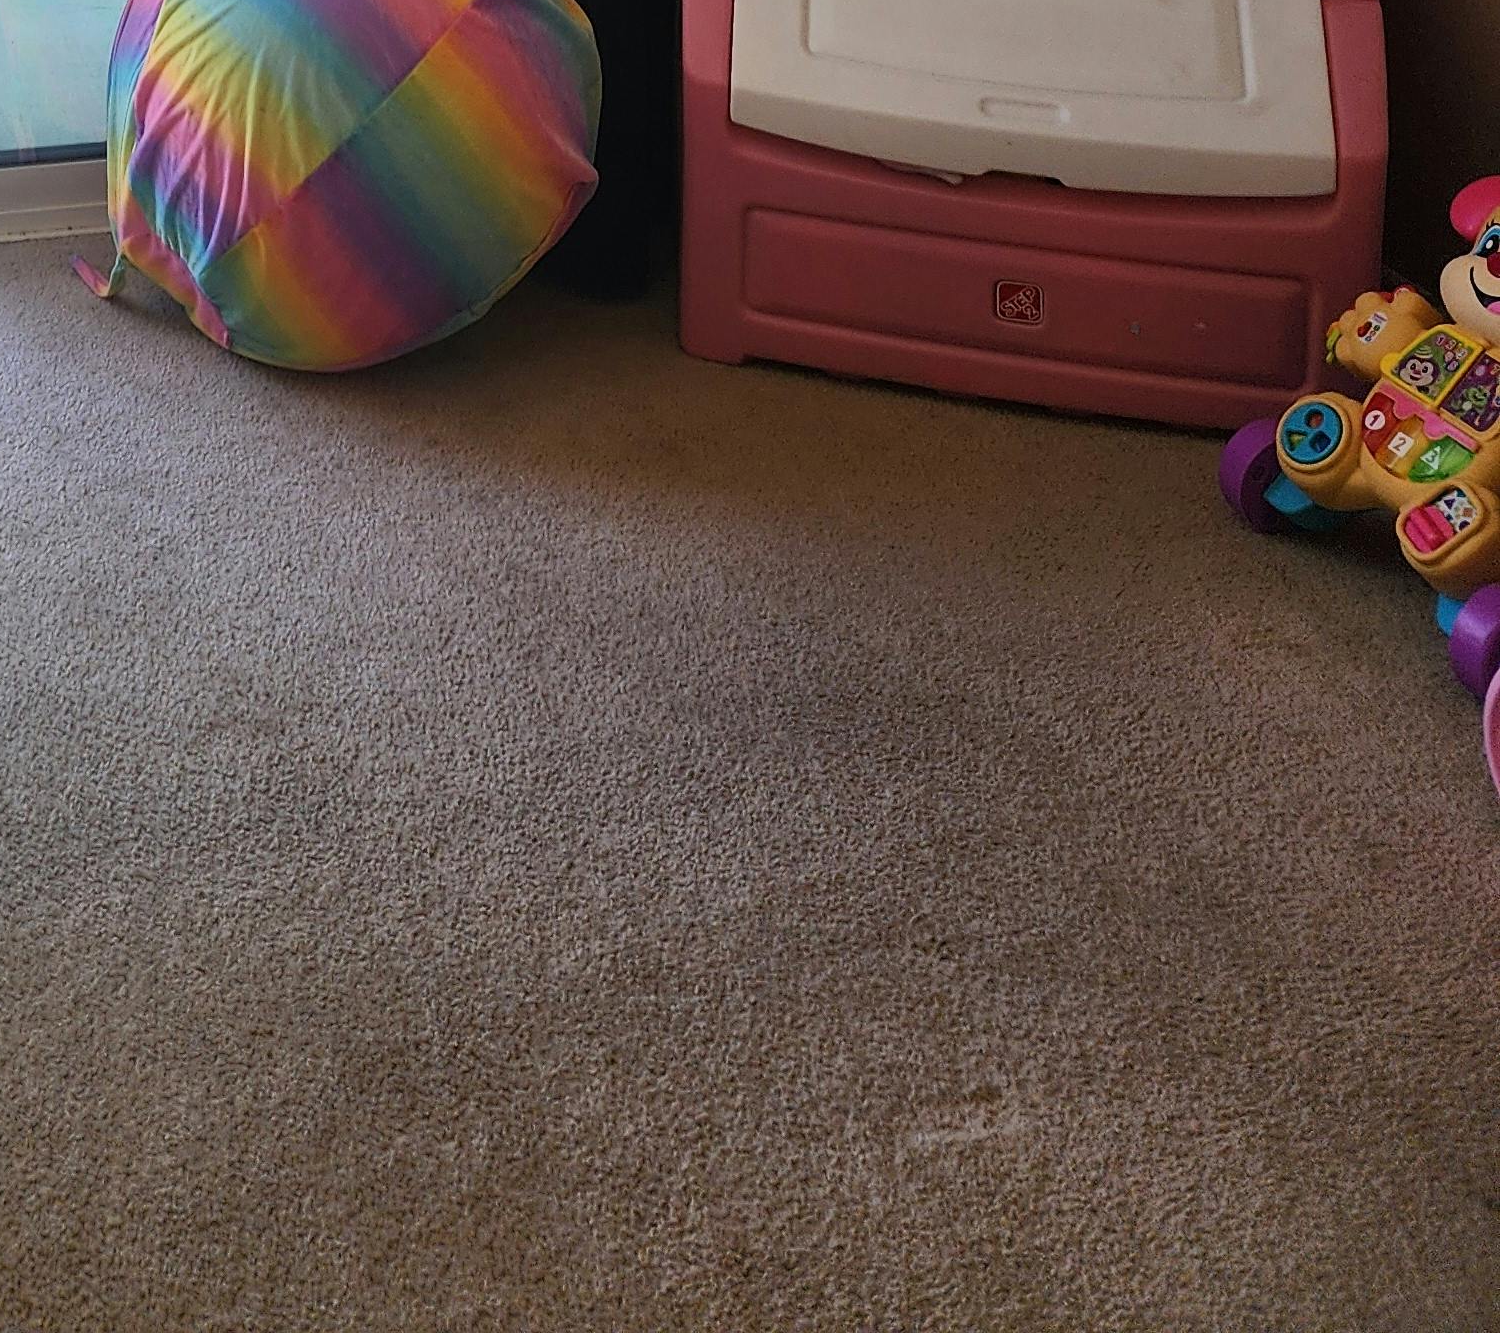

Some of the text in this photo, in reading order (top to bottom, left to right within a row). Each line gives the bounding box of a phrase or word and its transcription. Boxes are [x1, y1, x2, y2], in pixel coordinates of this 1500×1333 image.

[1369, 414, 1381, 426] 1
[1395, 437, 1407, 452] 2
[1425, 450, 1438, 464] 3
